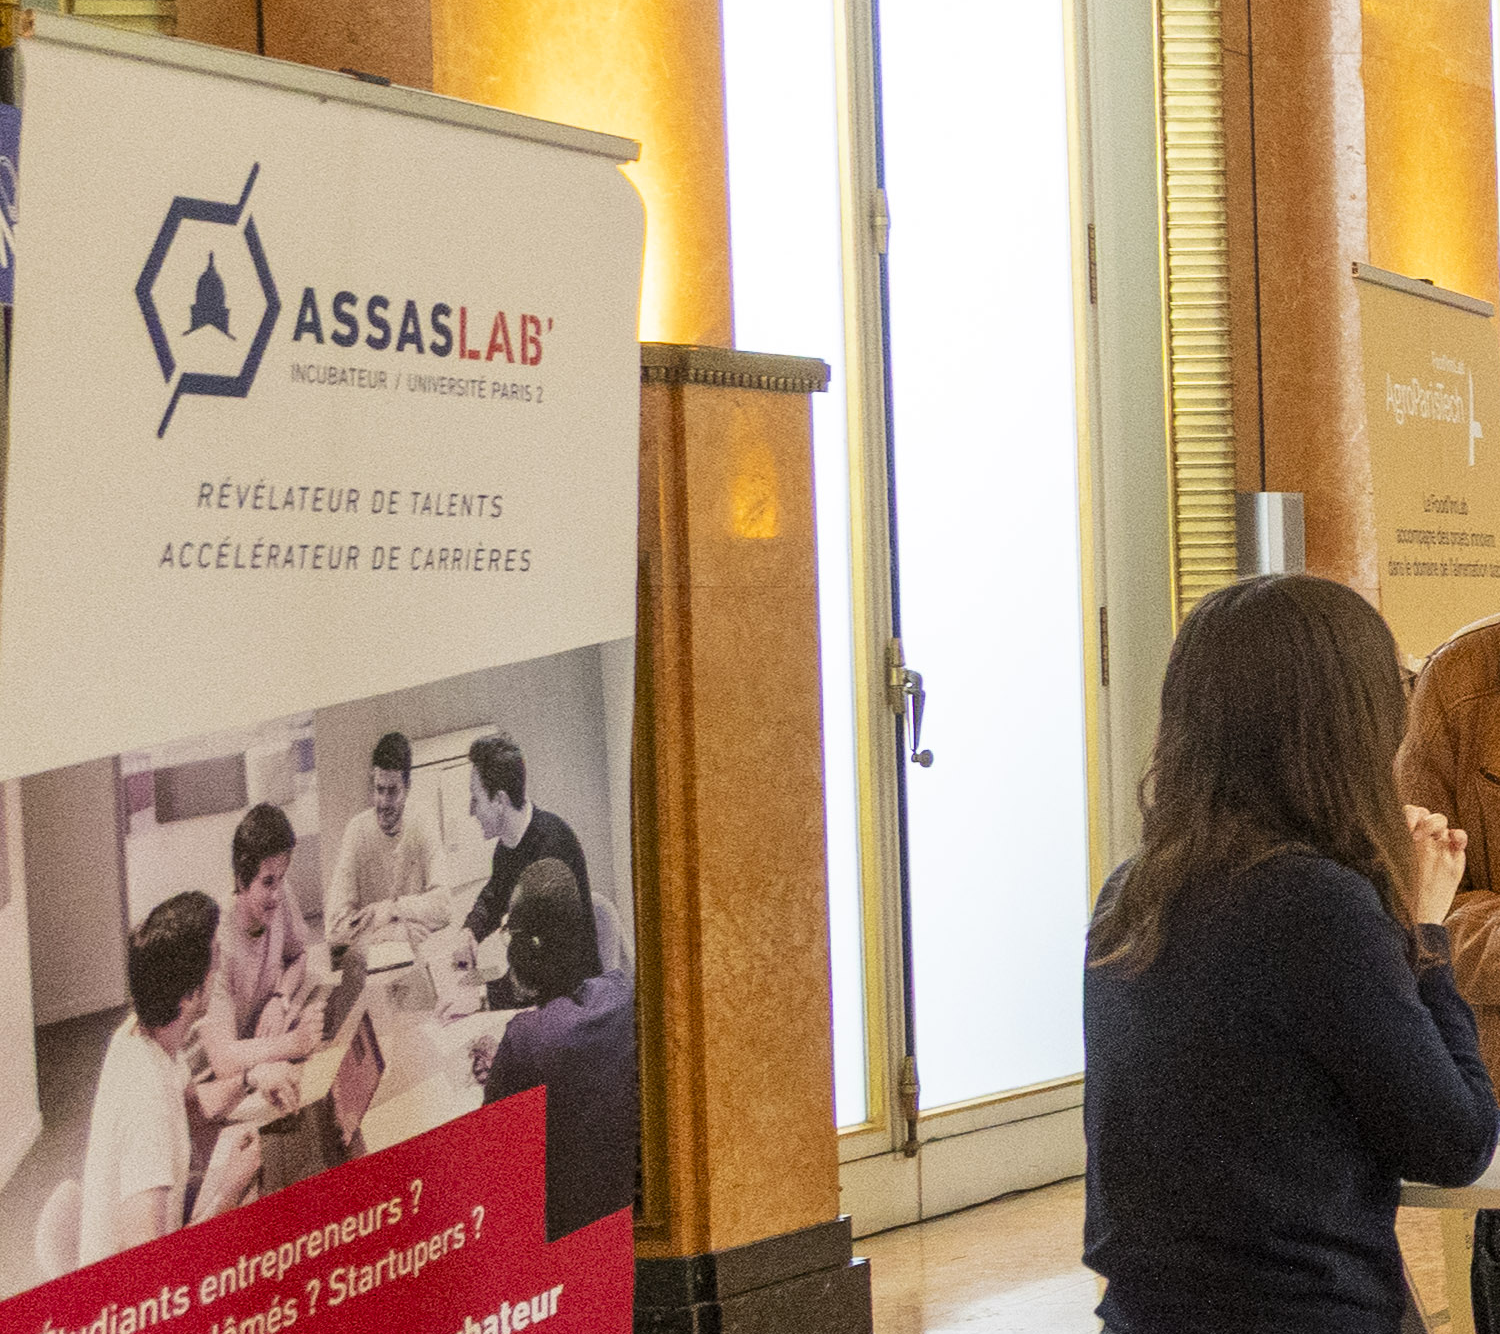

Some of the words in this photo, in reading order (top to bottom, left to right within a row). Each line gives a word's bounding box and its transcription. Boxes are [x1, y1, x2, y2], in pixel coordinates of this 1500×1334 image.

[290, 362, 387, 391] INCUBATEUR
[407, 372, 487, 400] UNIVERSITÉ
[491, 380, 533, 403] PARIS
[534, 386, 544, 404] 2
[198, 479, 360, 515] RÉVÉLATEUR
[370, 490, 402, 516] DE
[408, 491, 505, 520] TALENTS
[160, 538, 360, 572] ACCÉLÉRATEUR
[370, 545, 402, 572] DE
[408, 539, 533, 573] CARRIÈRES
[199, 1195, 403, 1308] entrepreneurs
[327, 1224, 466, 1307] Startupers
